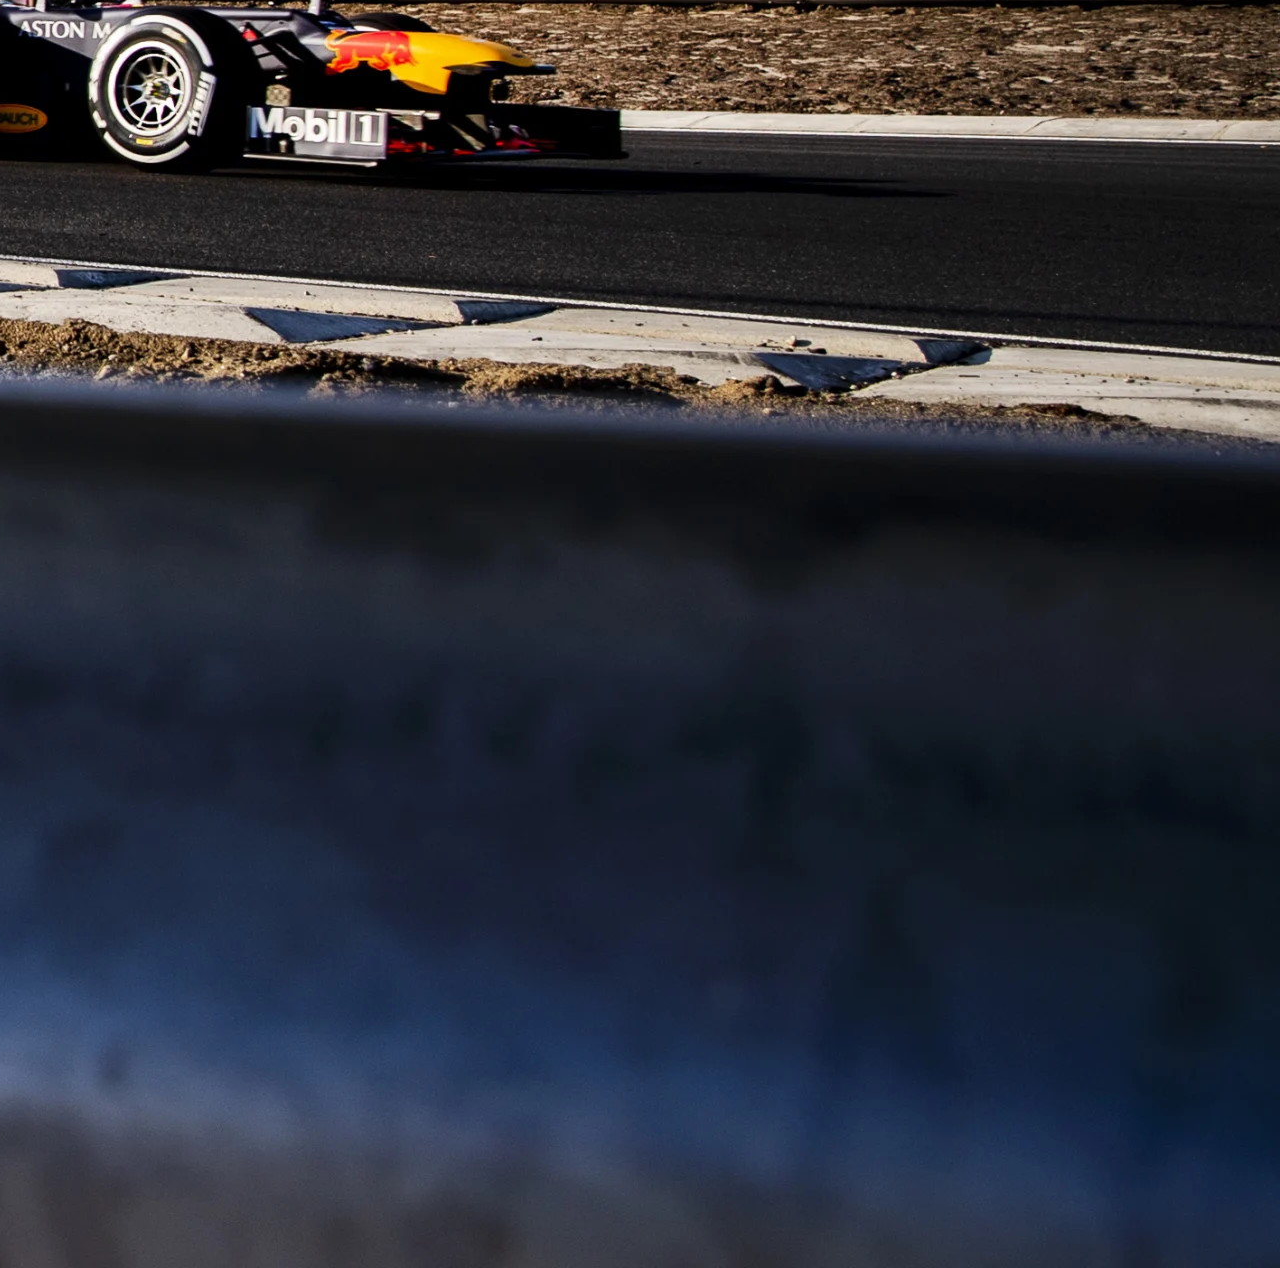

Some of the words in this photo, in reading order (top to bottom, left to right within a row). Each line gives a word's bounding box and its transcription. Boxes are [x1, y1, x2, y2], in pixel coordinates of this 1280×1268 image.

[18, 20, 85, 39] ASTON
[250, 107, 346, 143] Mobil
[358, 114, 372, 143] 1
